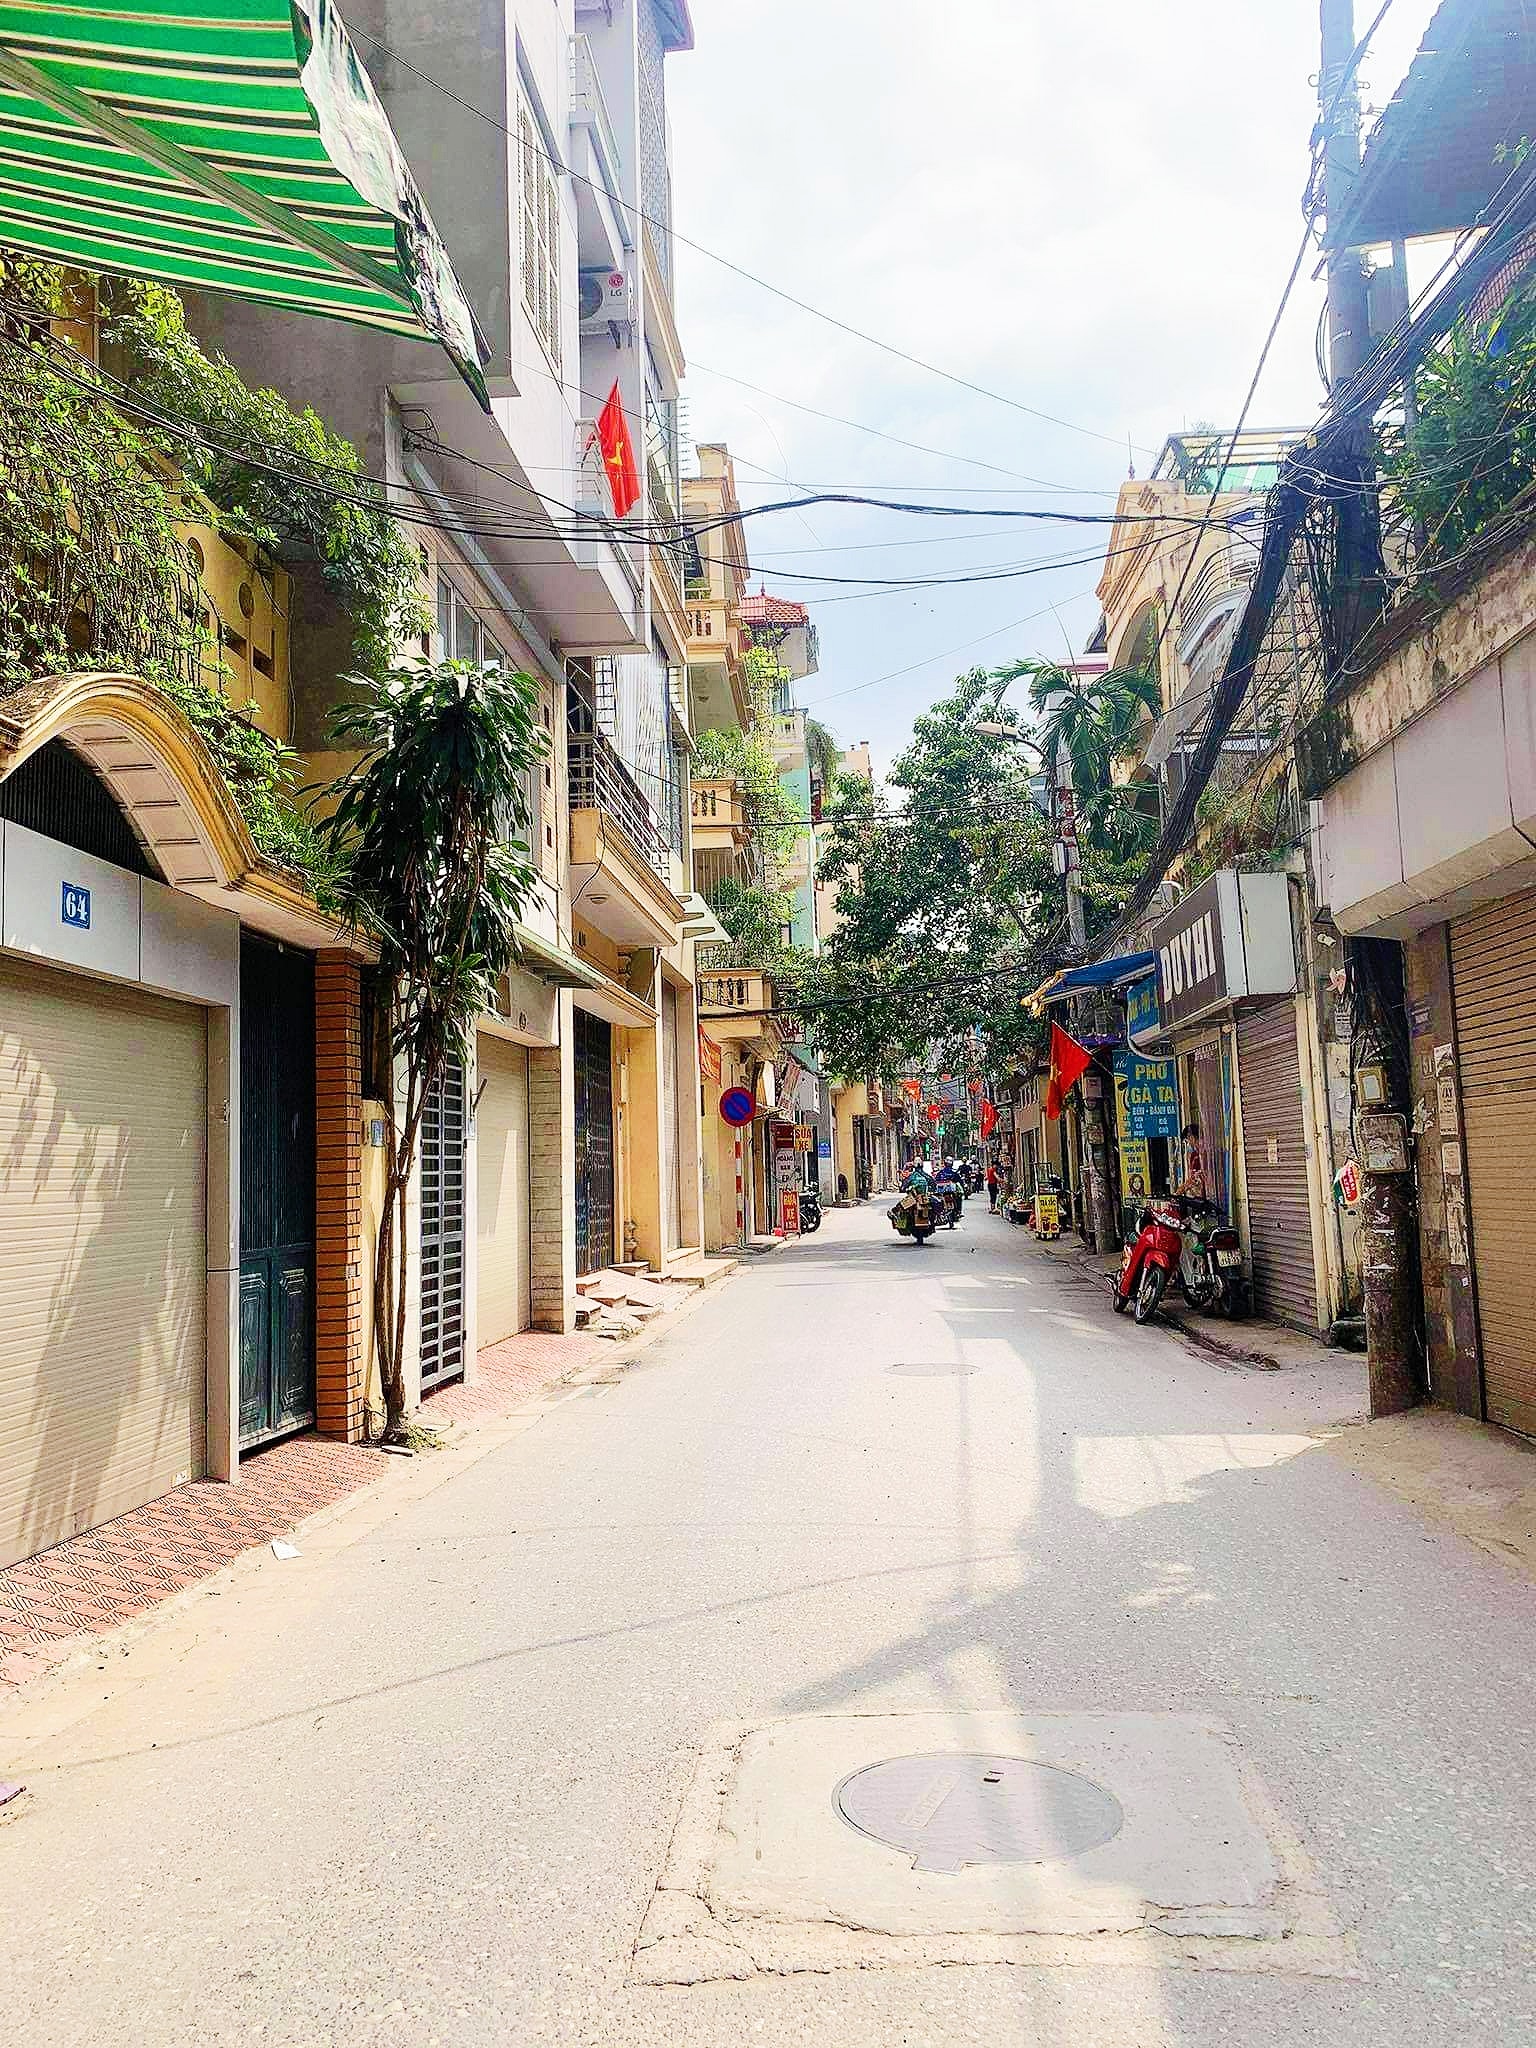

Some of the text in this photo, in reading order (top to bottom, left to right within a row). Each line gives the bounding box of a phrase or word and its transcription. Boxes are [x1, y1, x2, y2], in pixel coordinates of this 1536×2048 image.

[610, 288, 622, 297] LG
[66, 891, 89, 921] 64
[1130, 1083, 1174, 1104] GÀ TA
